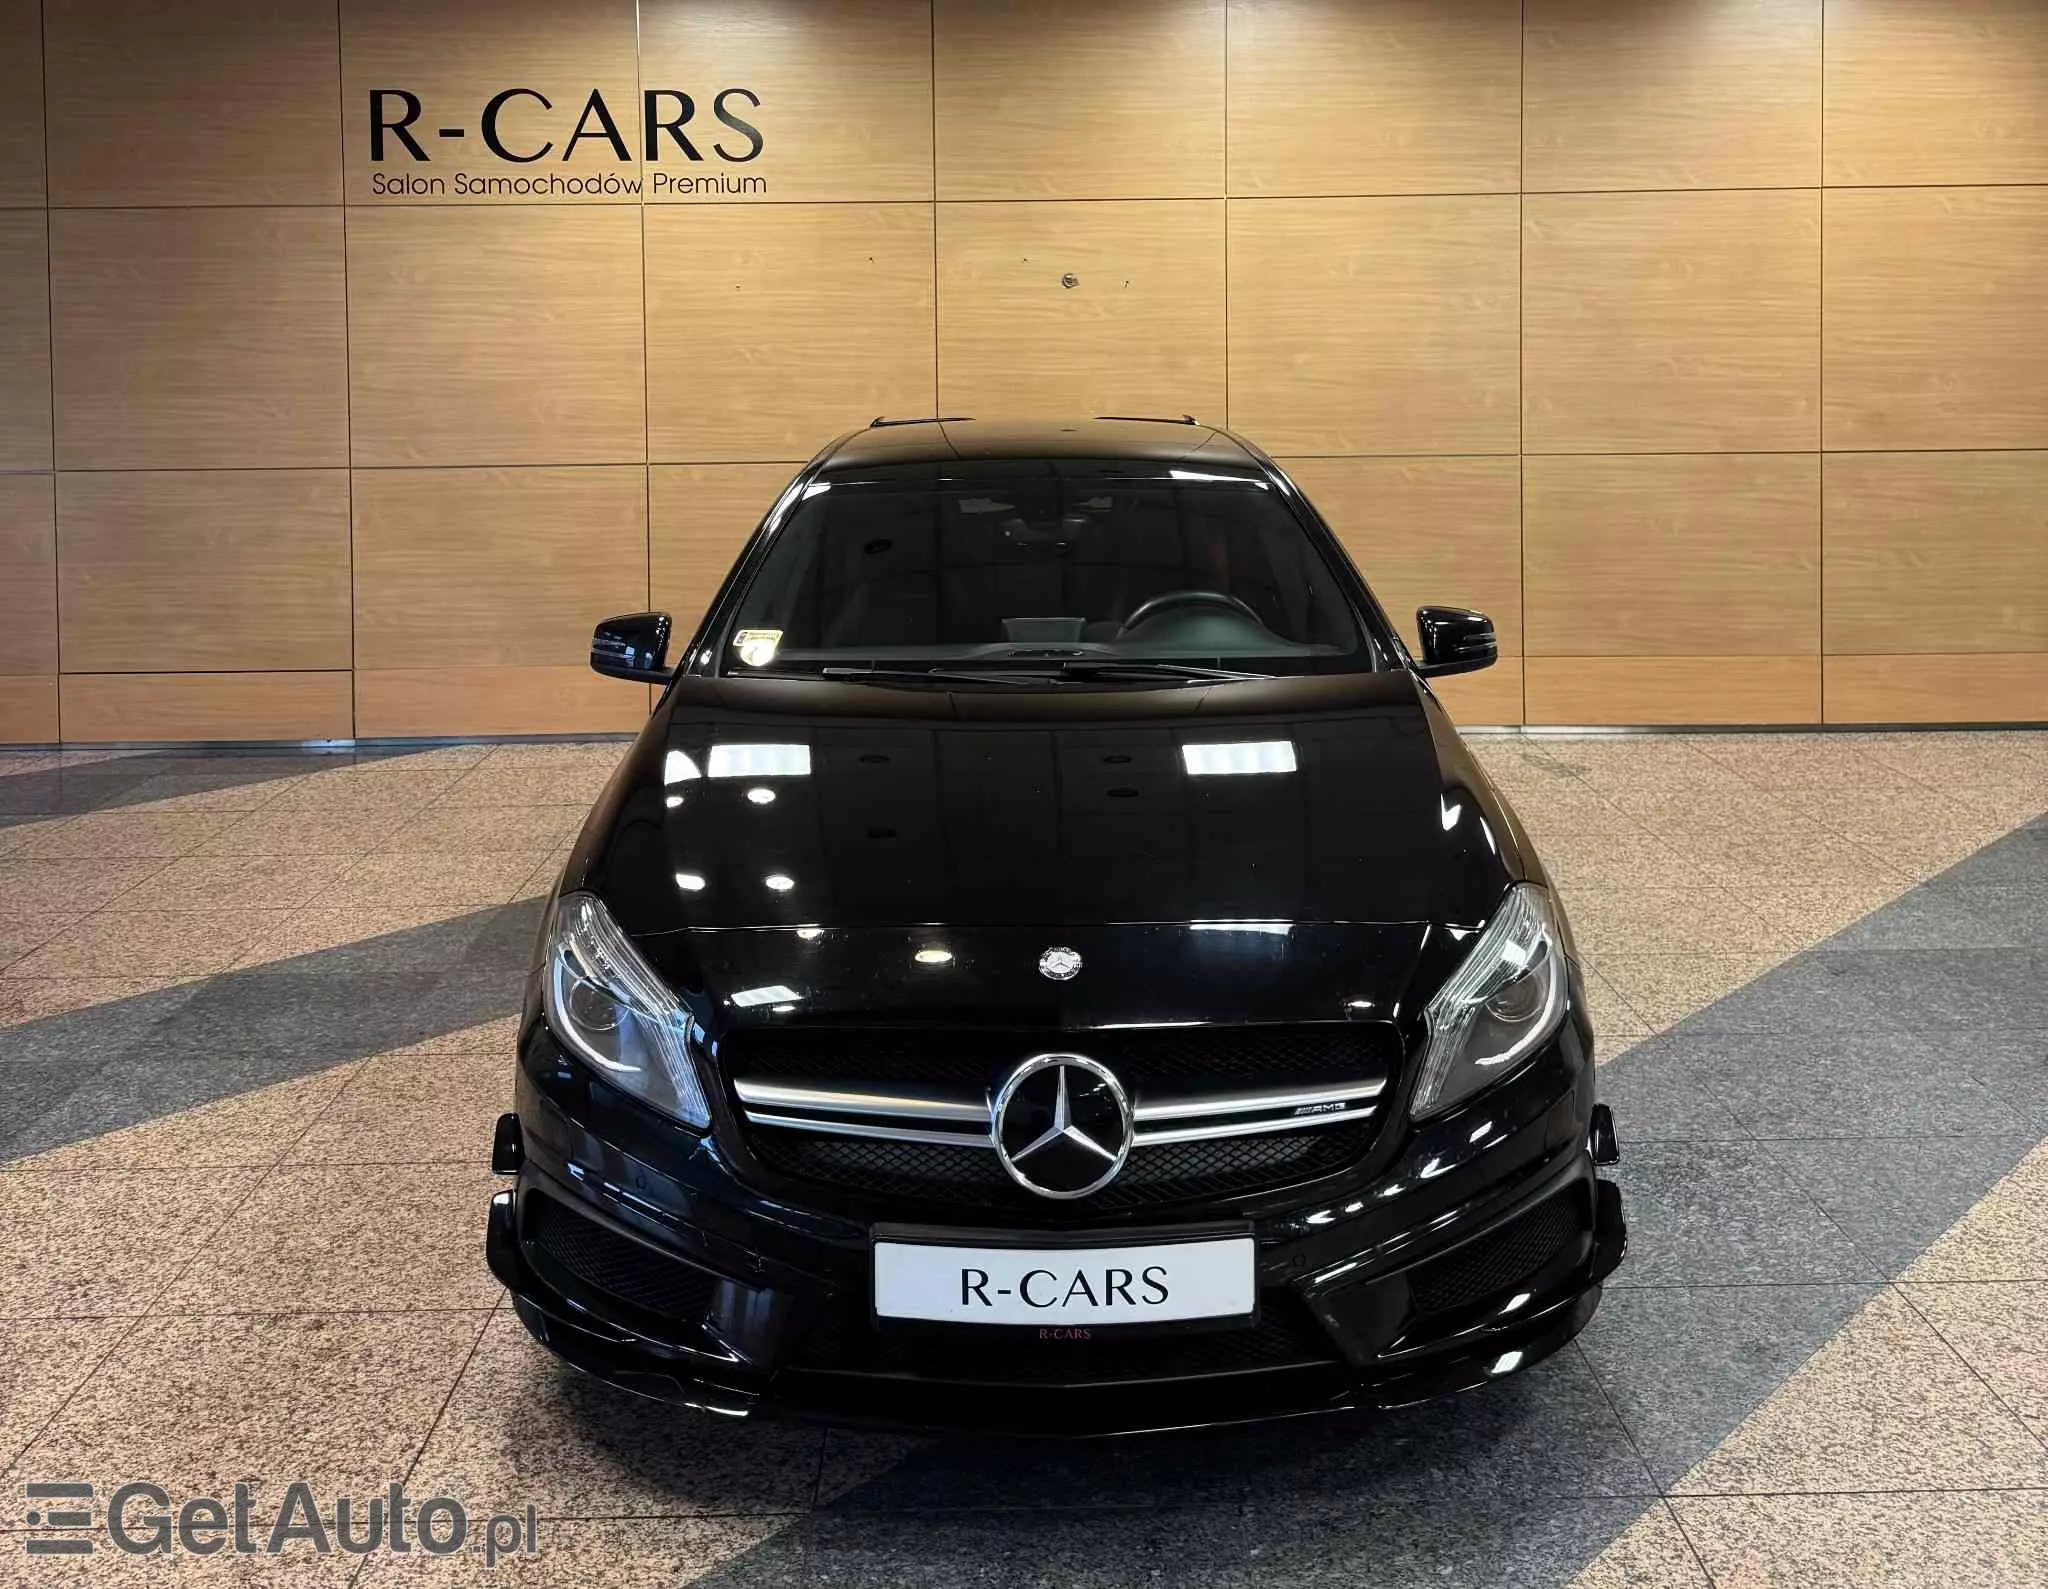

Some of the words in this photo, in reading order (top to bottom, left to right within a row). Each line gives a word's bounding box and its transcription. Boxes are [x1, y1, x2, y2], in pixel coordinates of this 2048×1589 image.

[369, 88, 764, 163] R-CARS
[372, 172, 445, 195] Salon
[454, 172, 642, 195] Samochodów
[653, 172, 767, 195] Premium
[960, 1265, 1170, 1309] R-CARS
[1038, 1327, 1092, 1341] R-CARS
